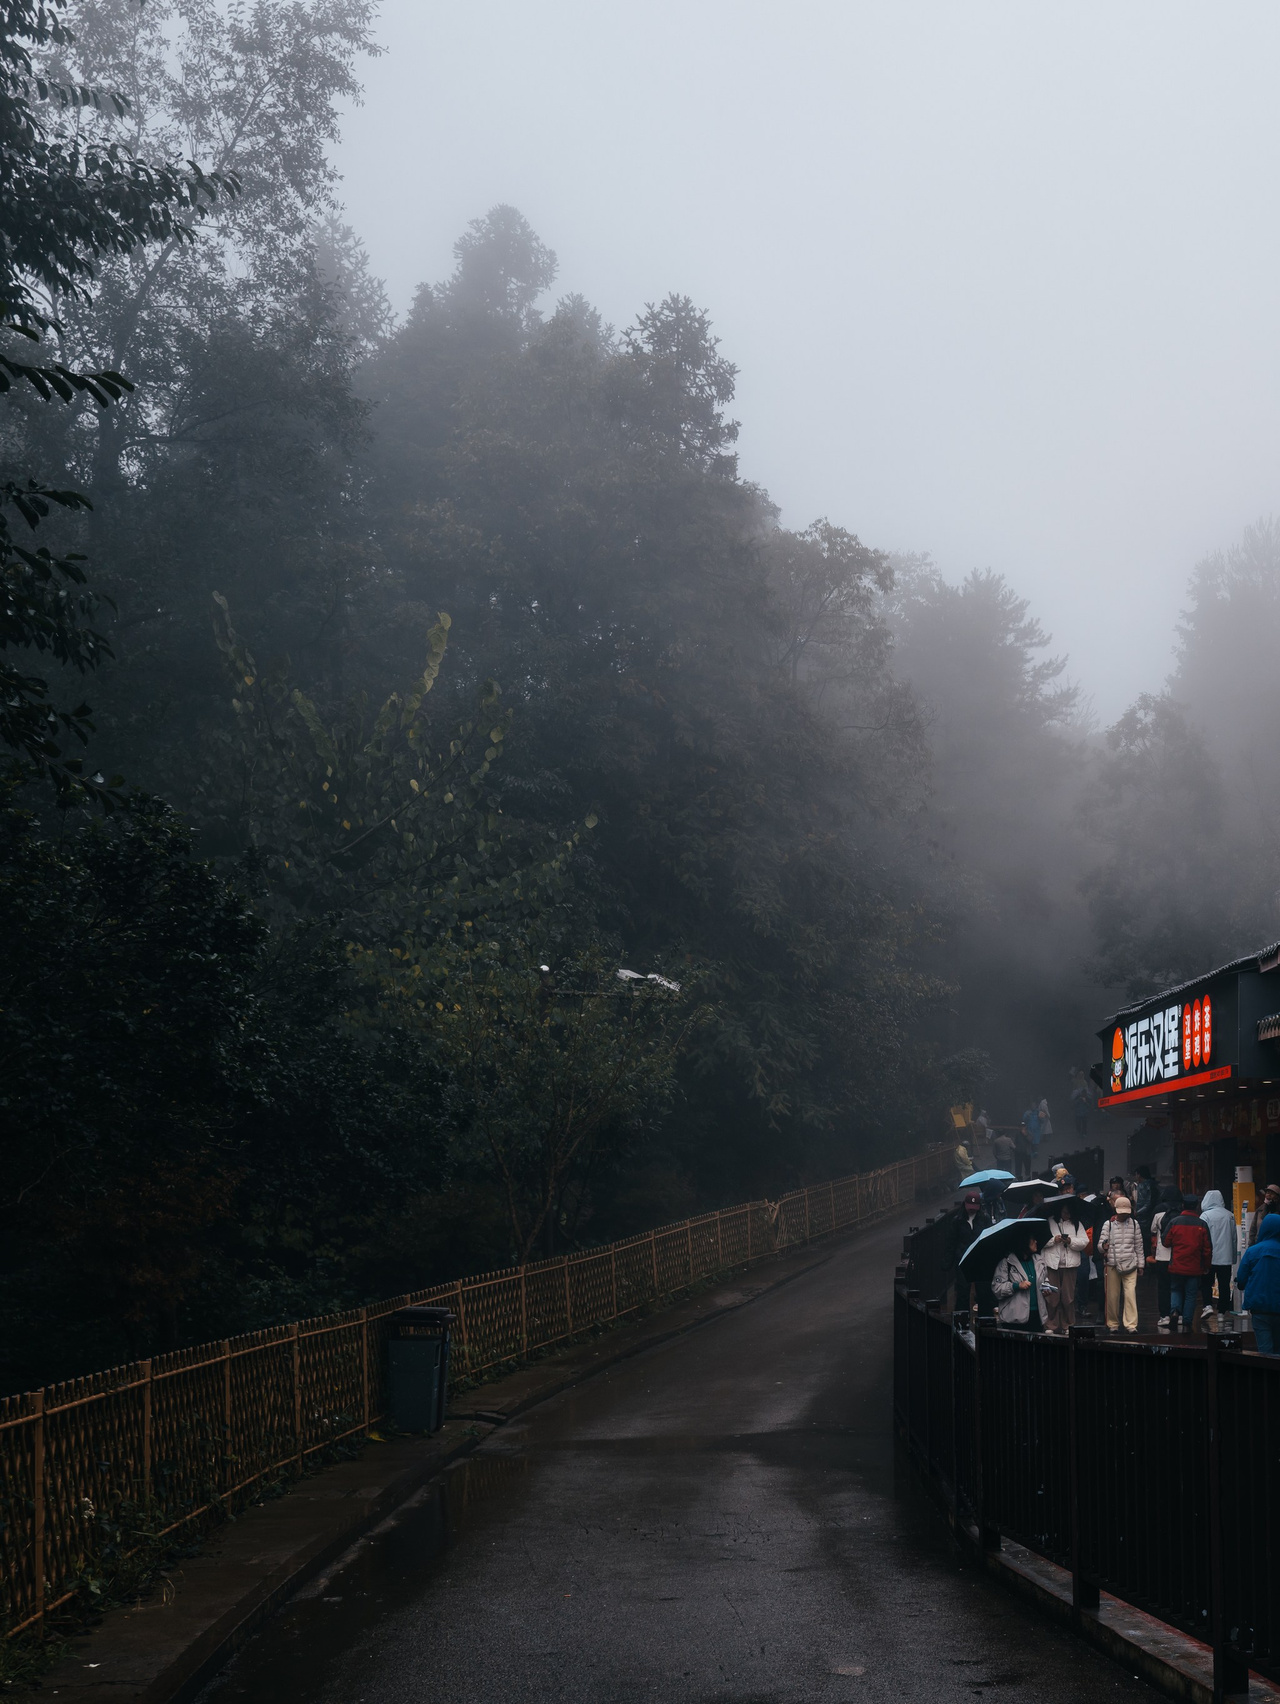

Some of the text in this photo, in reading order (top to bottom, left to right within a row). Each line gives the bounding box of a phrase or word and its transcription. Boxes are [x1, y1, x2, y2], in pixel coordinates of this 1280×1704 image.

[1124, 1004, 1179, 1090] 派乐汉堡
[1185, 1014, 1191, 1060] 汉堡
